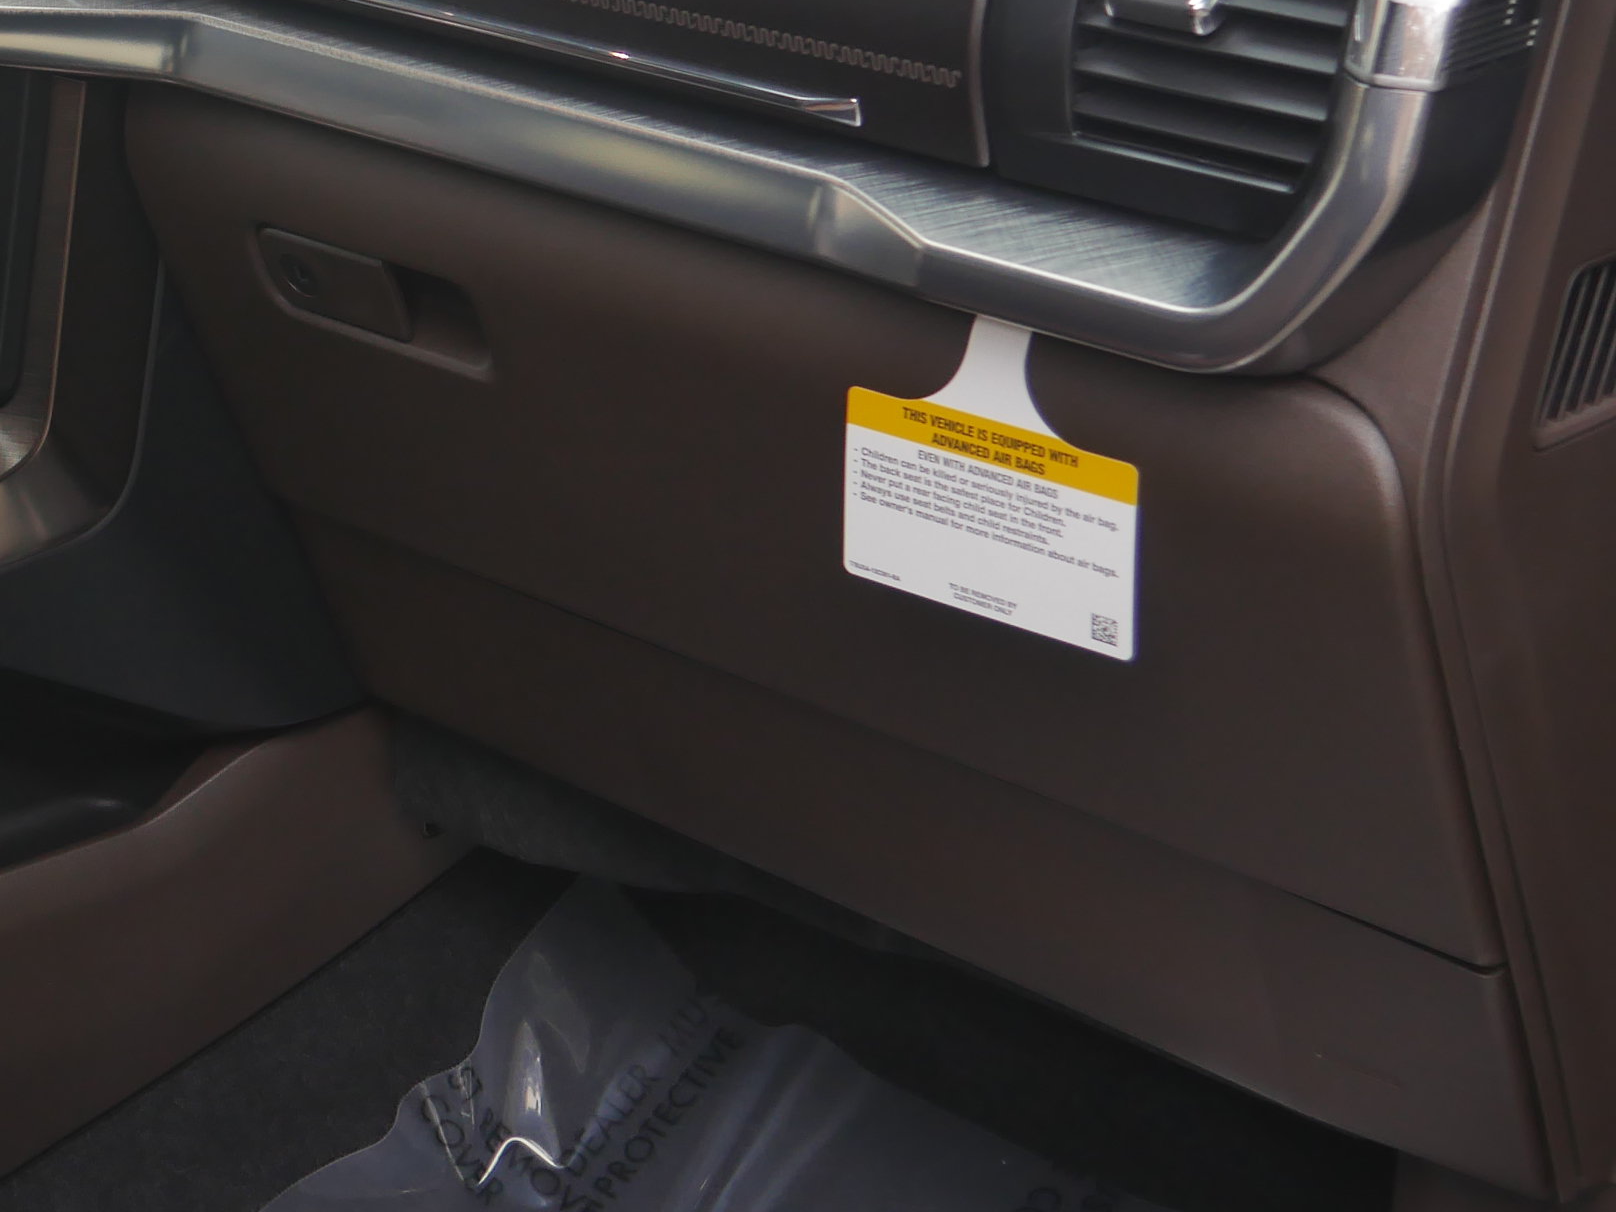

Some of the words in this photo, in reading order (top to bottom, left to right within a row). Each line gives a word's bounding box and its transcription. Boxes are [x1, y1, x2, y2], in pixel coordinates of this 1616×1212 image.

[902, 406, 927, 424] THIS
[930, 414, 975, 437] VEHICLE
[977, 428, 988, 441] IS
[991, 432, 1046, 458] EQUIPPED
[1049, 448, 1079, 467] WITH
[931, 433, 990, 459] ADVANCED
[993, 450, 1012, 466] AIR
[1015, 456, 1046, 476] BAGS
[861, 447, 899, 465] Children
[901, 459, 917, 470] can
[919, 464, 931, 475] be
[933, 468, 957, 483] killed
[959, 477, 969, 486] or
[971, 478, 1013, 500] seriously
[1016, 493, 1049, 510] injured
[1051, 503, 1062, 516] by
[1065, 508, 1080, 519] the
[1083, 514, 1095, 523] air
[1097, 518, 1119, 532] bag.
[861, 458, 877, 471] The
[879, 464, 900, 477] back
[903, 472, 923, 484] seat
[924, 478, 932, 487] is
[934, 480, 949, 491] the
[951, 486, 978, 500] safest
[981, 495, 1005, 509] place
[1007, 502, 1021, 512] for
[1024, 506, 1067, 527] Children.
[861, 469, 886, 484] Never
[888, 478, 903, 490] put
[905, 484, 911, 492] a
[912, 487, 931, 497] rear
[932, 491, 961, 508] facing
[962, 501, 986, 514] child
[988, 509, 1008, 522] seat
[1009, 514, 1018, 524] in
[1021, 518, 1036, 529] the
[1038, 522, 1064, 538] front.
[918, 449, 940, 464] EVEN
[943, 456, 965, 472] WITH
[967, 464, 1014, 486] ADVANCED
[1017, 478, 1032, 490] AIR
[1034, 483, 1059, 499] BAGS
[860, 481, 892, 497] Always
[894, 492, 910, 503] use
[913, 497, 932, 509] seat
[933, 502, 956, 517] belts
[958, 511, 976, 523] and
[977, 516, 1001, 530] child
[1002, 525, 1050, 545] restraints.
[860, 491, 877, 504] See
[879, 499, 913, 515] owner's
[915, 509, 948, 526] manual
[950, 519, 963, 530] for
[966, 525, 990, 538] more
[991, 532, 1045, 555] information
[1047, 550, 1075, 564] about
[1077, 559, 1090, 568] air
[1091, 562, 1119, 578] bags.
[566, 1063, 663, 1178] DEALER
[592, 1025, 744, 1201] PROTECTIVE
